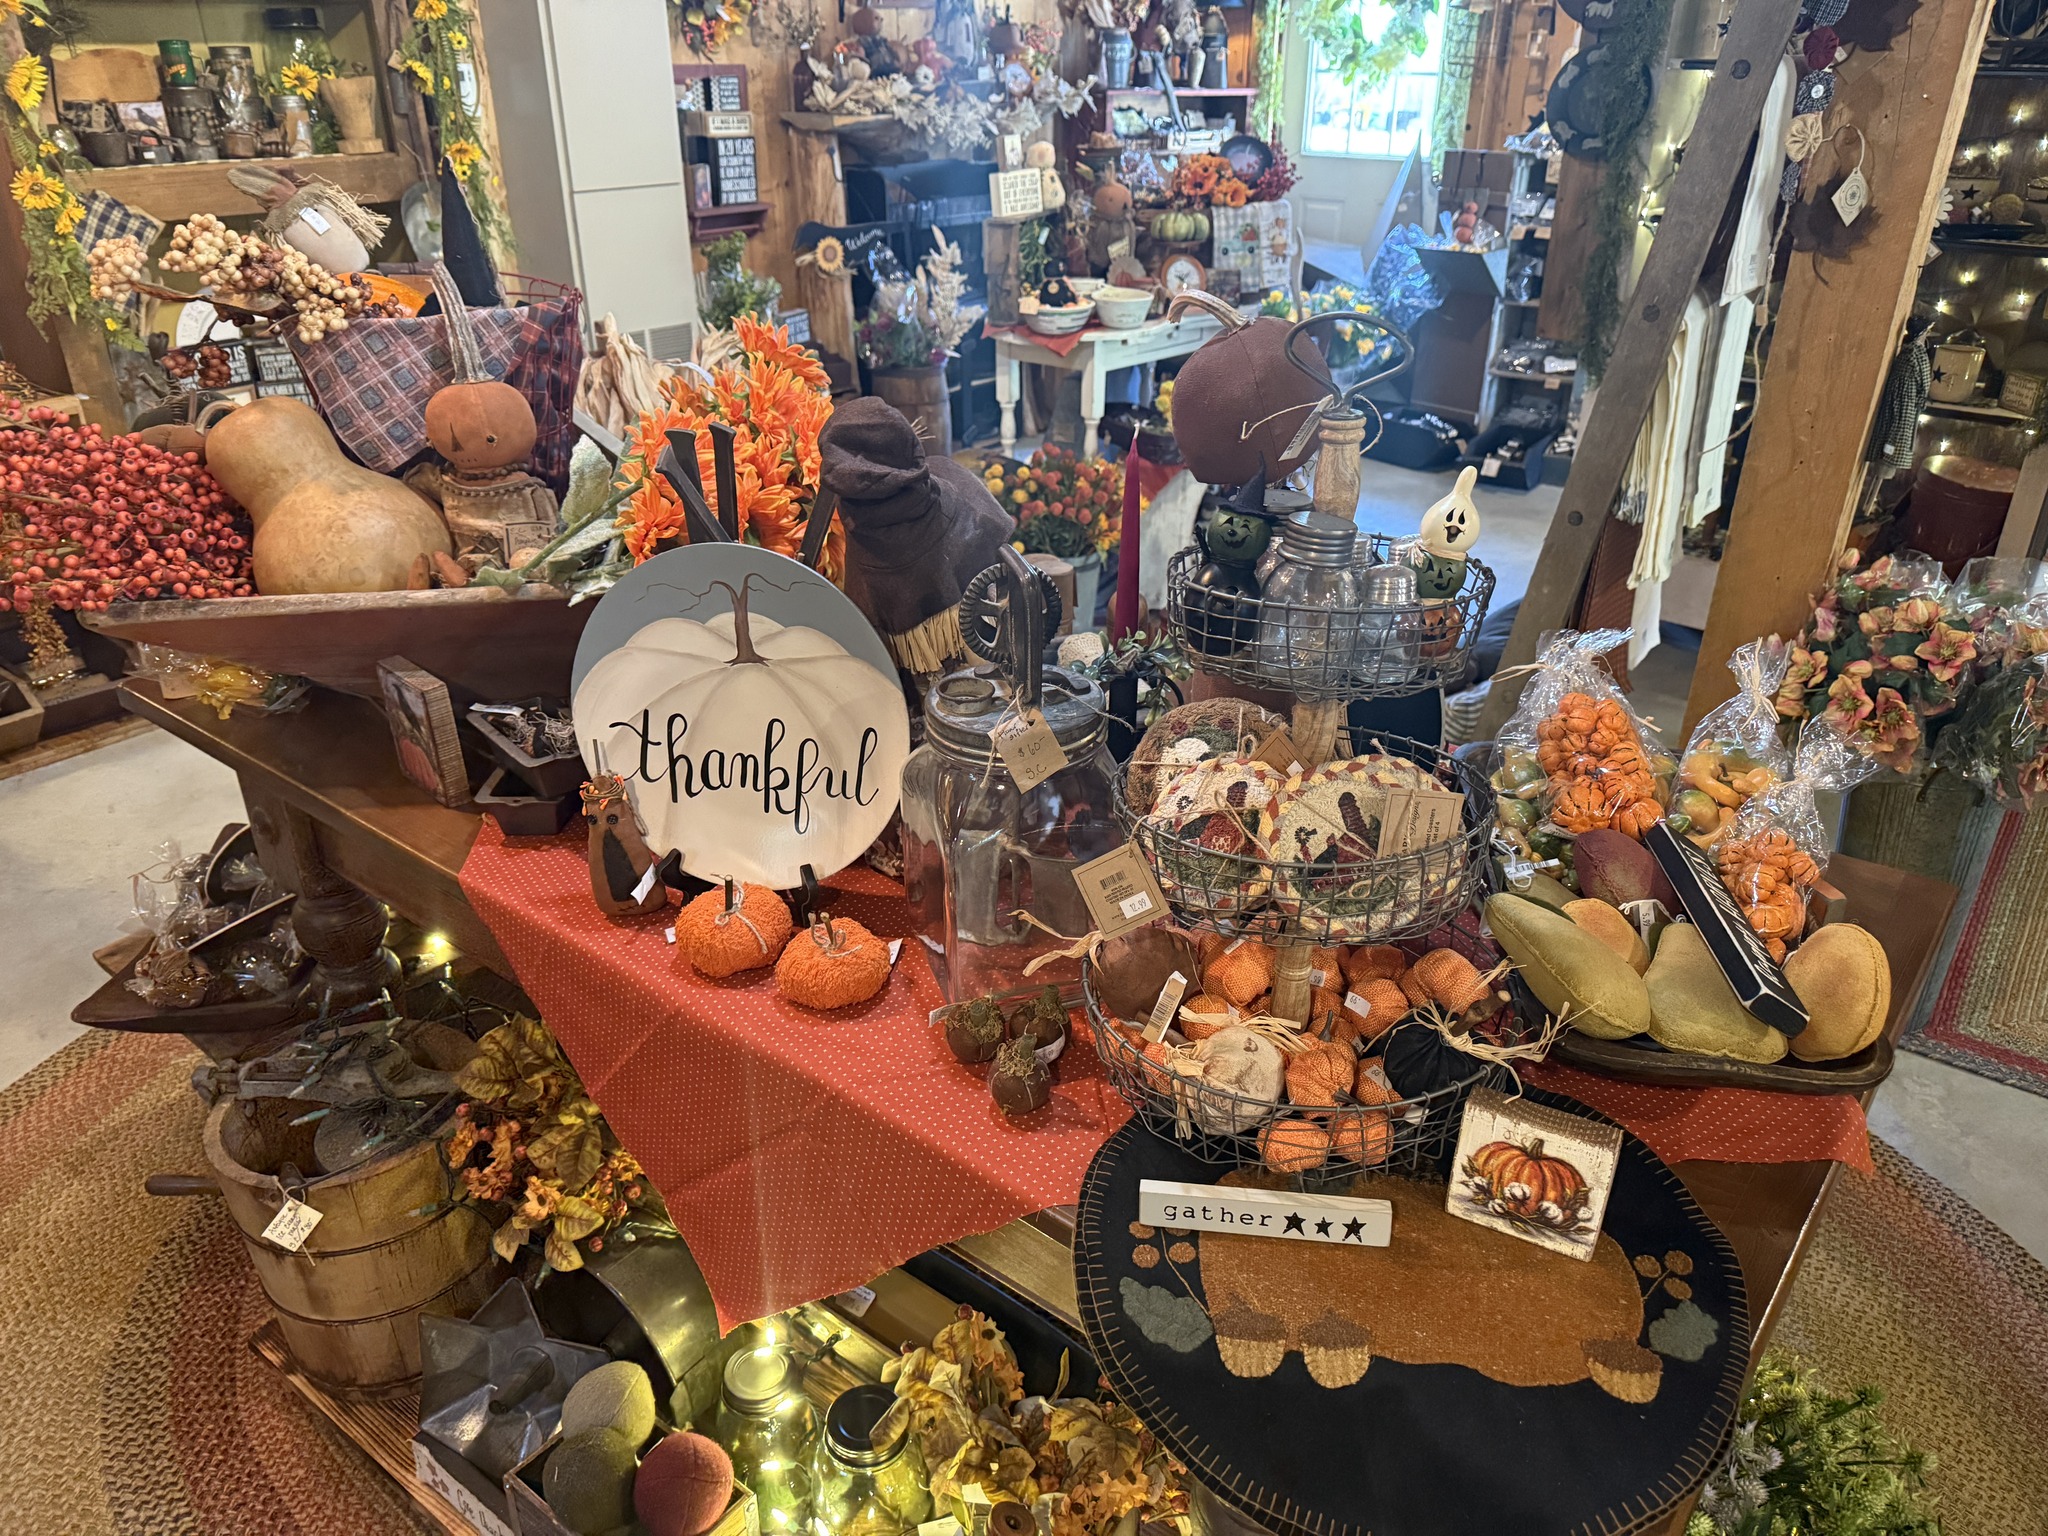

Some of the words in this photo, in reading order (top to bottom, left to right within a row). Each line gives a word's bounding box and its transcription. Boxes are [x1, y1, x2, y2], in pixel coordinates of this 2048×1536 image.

[845, 229, 885, 251] Welcome
[609, 708, 879, 835] thankful
[1426, 808, 1436, 833] Coasters
[1678, 839, 1747, 925] HARVEST
[1129, 897, 1147, 912] 12.99
[1642, 912, 1651, 927] 5.99
[1163, 1204, 1273, 1227] gather
